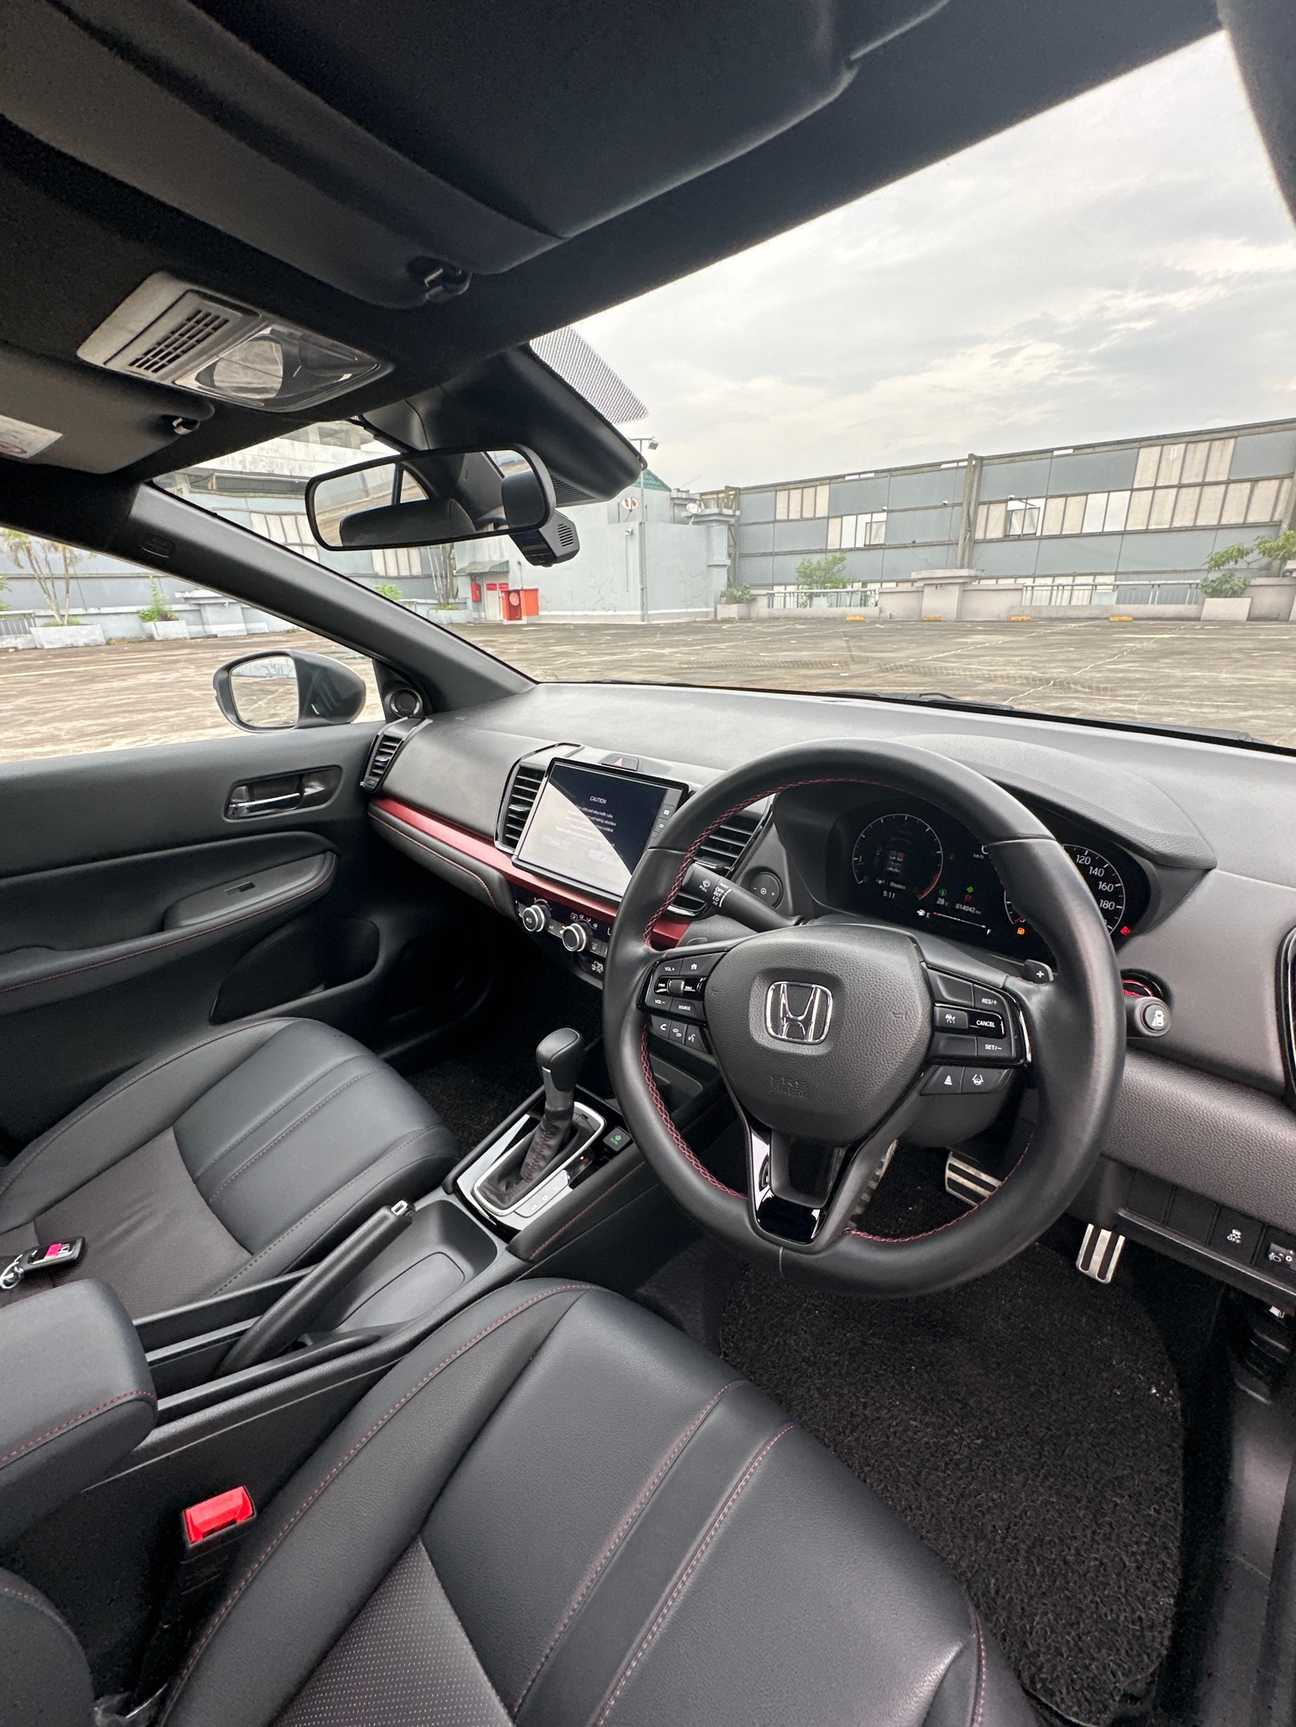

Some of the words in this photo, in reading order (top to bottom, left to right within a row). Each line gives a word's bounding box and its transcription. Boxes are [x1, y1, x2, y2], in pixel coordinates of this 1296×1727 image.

[1075, 854, 1092, 865] 120
[1088, 865, 1105, 877] 140
[1098, 881, 1114, 892] 160
[1099, 899, 1115, 911] 180
[976, 1019, 996, 1028] CANCEL
